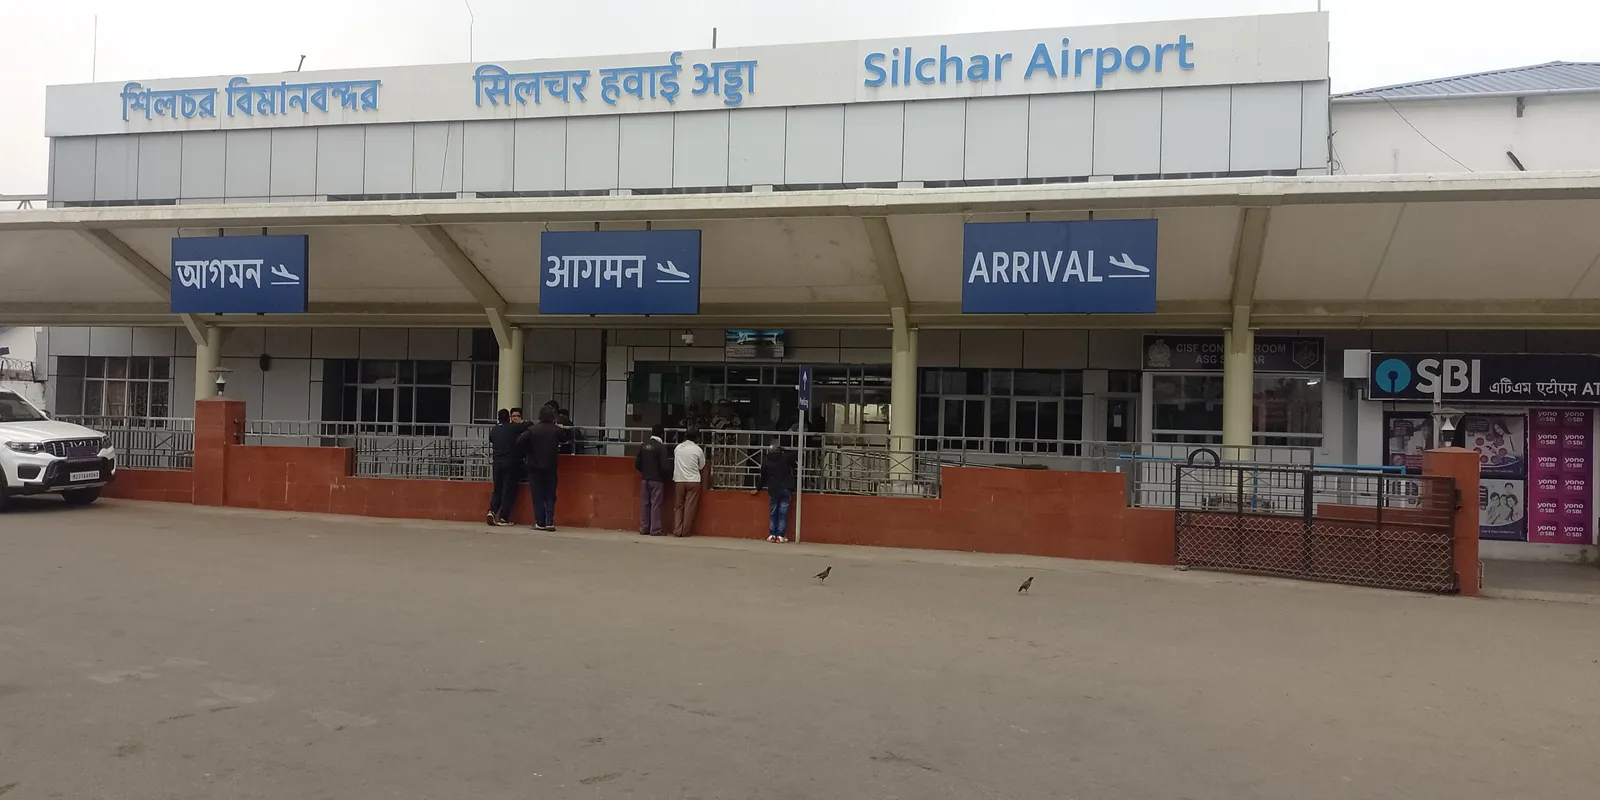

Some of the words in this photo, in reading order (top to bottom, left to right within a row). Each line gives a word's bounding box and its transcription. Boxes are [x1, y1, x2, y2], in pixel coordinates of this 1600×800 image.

[864, 44, 1013, 87] Silchar
[1024, 34, 1195, 88] Airport
[472, 64, 591, 107] सिलचर
[599, 51, 683, 105] हवाई
[692, 60, 758, 107] अड्डा
[120, 82, 219, 121] শিলচর
[225, 76, 382, 117] বিমানবন্দর
[175, 259, 264, 289] আগমন
[545, 255, 647, 288] आगमन
[968, 250, 1103, 283] ARRIVAL
[1176, 343, 1198, 353] CISF
[1255, 343, 1286, 354] ROOM
[1195, 355, 1217, 364] ASG
[1415, 358, 1481, 394] SBI
[1489, 377, 1531, 394] এটিএম
[1536, 378, 1577, 397] एटीएम
